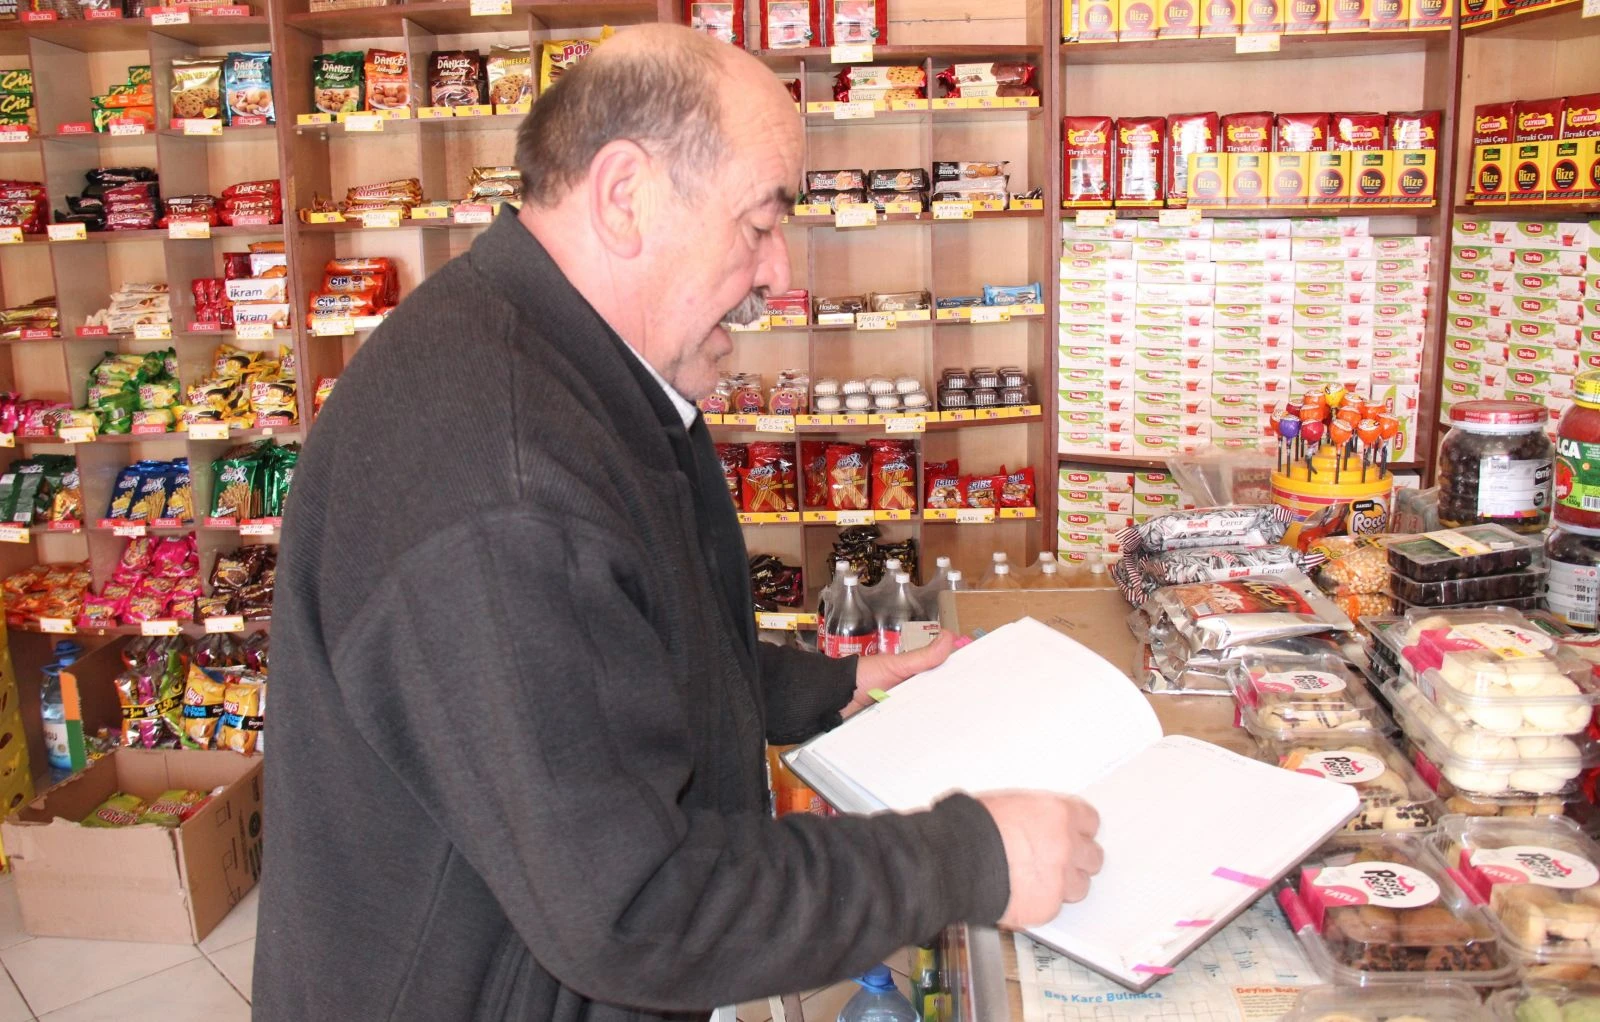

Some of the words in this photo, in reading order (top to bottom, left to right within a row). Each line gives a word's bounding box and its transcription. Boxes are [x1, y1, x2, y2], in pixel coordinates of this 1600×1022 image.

[1296, 3, 1315, 14] Rize
[1340, 1, 1359, 11] Rize
[1377, 1, 1398, 12] Rize
[1421, 0, 1442, 8] Rize
[1169, 6, 1188, 18] Rize
[1211, 5, 1231, 16] Rize
[1253, 4, 1273, 15] Rize
[1089, 13, 1108, 23] Rize
[1129, 10, 1149, 21] Rize
[437, 58, 471, 69] DANKEK
[1516, 134, 1537, 142] Tiryaki
[1564, 131, 1586, 139] Tiryaki
[1474, 137, 1492, 145] Tiryaki
[1067, 148, 1091, 157] Tiryaki
[1482, 171, 1499, 184] Rize
[1518, 169, 1536, 182] Rize
[1555, 167, 1575, 181] Rize
[1198, 179, 1217, 189] Rize
[1238, 178, 1257, 189] Rize
[1279, 177, 1298, 188] Rize
[1320, 177, 1340, 188] Rize
[1361, 176, 1381, 187] Rize
[1402, 176, 1423, 187] Rize
[1463, 223, 1476, 231] Torku
[1527, 224, 1542, 232] Torku
[1073, 242, 1093, 252] Torku
[1461, 250, 1476, 258] Torku
[1524, 253, 1542, 262] Torku
[1524, 278, 1541, 286] Torku
[230, 288, 263, 298] ikram
[1381, 285, 1398, 293] Torku
[1522, 301, 1540, 310] Torku
[1307, 307, 1325, 315] Torku
[1379, 307, 1397, 315] Torku
[235, 311, 268, 322] ikram
[1456, 319, 1472, 327] Torku
[1521, 325, 1538, 334] Torku
[1454, 341, 1470, 349] Torku
[1518, 349, 1536, 358] Torku
[1454, 361, 1468, 369] Torku
[1515, 373, 1534, 382] Torku
[1452, 383, 1466, 391] Torku
[1069, 474, 1089, 482] Torku
[1148, 474, 1165, 482] Torku
[1068, 515, 1088, 523] Torku
[1353, 513, 1387, 532] Rocco
[1070, 533, 1087, 541] Torku
[1324, 756, 1357, 776] Pasta
[1483, 867, 1519, 882] TATLI
[1363, 869, 1407, 897] Pasta
[1323, 888, 1359, 903] TATLI
[1071, 992, 1102, 1004] Kare
[1106, 990, 1163, 1002] Bulmaca
